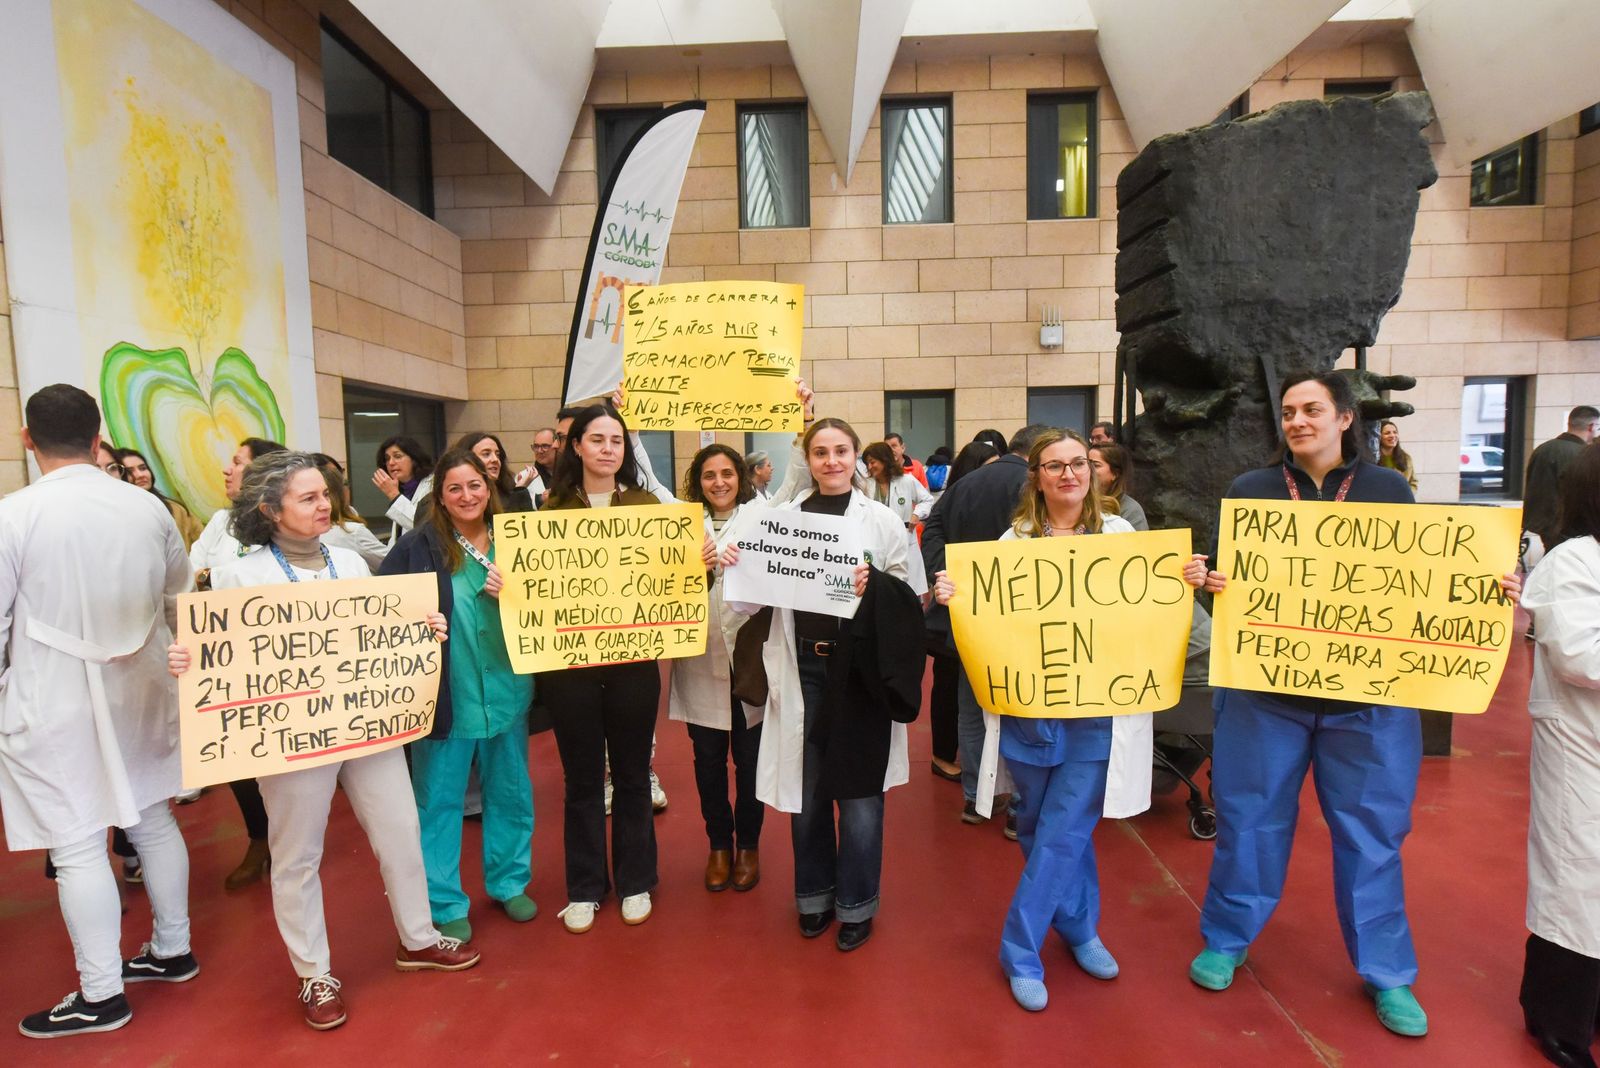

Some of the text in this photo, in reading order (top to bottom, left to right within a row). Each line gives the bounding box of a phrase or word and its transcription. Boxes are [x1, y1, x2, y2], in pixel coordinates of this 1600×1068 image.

[604, 223, 660, 257] SMA
[604, 250, 656, 268] CÓRDOBA
[628, 289, 644, 310] 6
[647, 293, 676, 306] AÑOS
[707, 293, 779, 303] CARRERA
[786, 299, 796, 310] +
[673, 320, 713, 336] AÑOS
[725, 322, 758, 336] MIR
[769, 326, 778, 336] +
[626, 350, 795, 369] FORMACION PERMA
[625, 375, 690, 390] NENTE
[668, 401, 763, 416] MERECEMOS
[770, 403, 801, 414] ESTA
[641, 418, 674, 428] TUTO
[537, 519, 568, 539] UN
[576, 517, 694, 541] CONDUCTOR
[793, 528, 839, 543] somos
[1232, 508, 1479, 563] PARA CONDUCIR
[512, 545, 686, 572] AGOTADO ES UN
[737, 540, 798, 557] esclavos
[802, 547, 819, 560] de
[824, 549, 858, 566] bata
[621, 570, 675, 597] ¿QUÉ
[684, 575, 704, 594] ES
[768, 561, 824, 580] blanca”
[825, 574, 856, 589] SMA
[972, 549, 1185, 615] MÉDICOS
[1232, 550, 1269, 582] NO
[1281, 557, 1318, 587] TE
[1330, 561, 1432, 598] DEJAN
[190, 593, 403, 634] UN CONDUCTOR
[519, 601, 706, 628] UN MÉDICO AGOTADO
[1244, 587, 1505, 647] 24 HORAS AGOTADO
[200, 640, 233, 670] NO
[250, 629, 339, 665] PUEDE
[519, 629, 698, 654] EN UNA GUARDIA DE
[1040, 618, 1093, 670] EN
[563, 647, 664, 665] 24 HORAS?
[1237, 630, 1491, 684] PERO PARA SALVAR
[195, 651, 437, 708] 24 HORAS SEGUIDAS
[987, 665, 1161, 706] HUELGA
[1260, 663, 1344, 691] VIDAS
[221, 685, 415, 732] PERO UN MÉDICO
[345, 700, 435, 741] SENTIDO?
